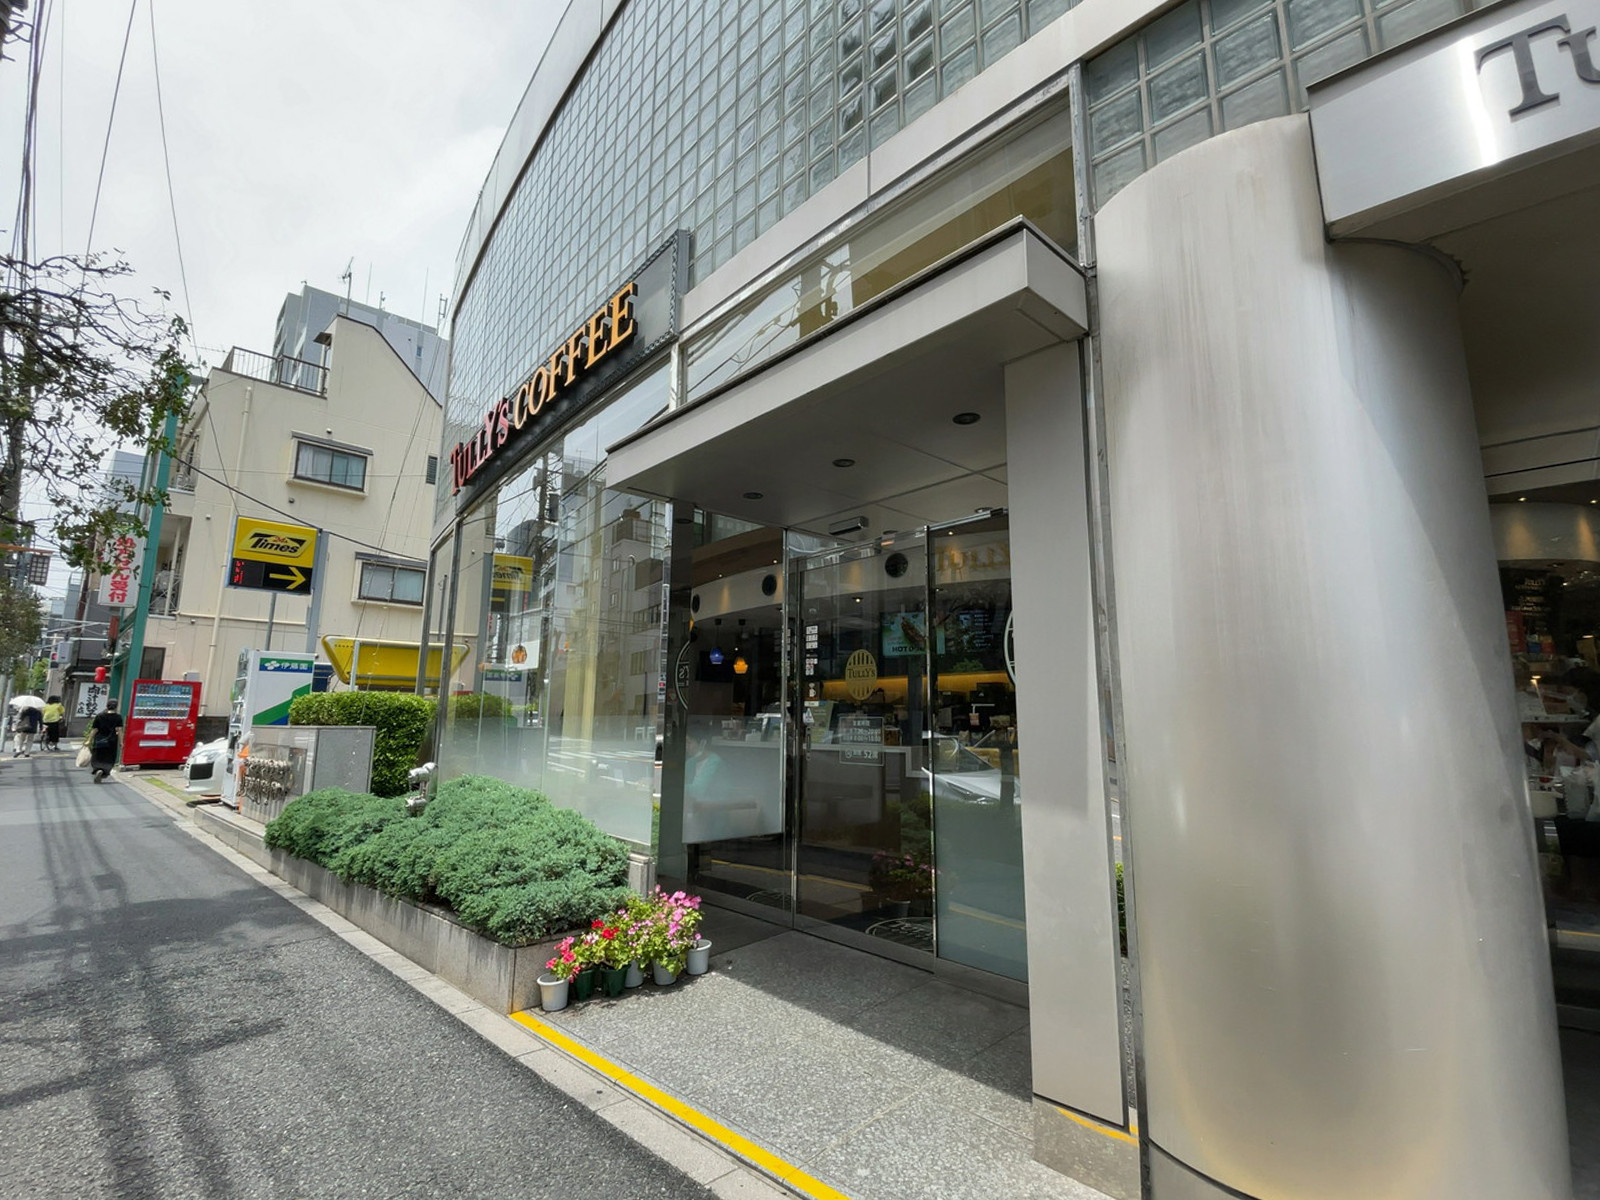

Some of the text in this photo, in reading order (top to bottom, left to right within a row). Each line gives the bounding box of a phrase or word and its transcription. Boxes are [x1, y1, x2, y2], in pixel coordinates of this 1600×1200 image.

[450, 282, 636, 495] TULLY'S COFFEE
[249, 532, 306, 553] Times
